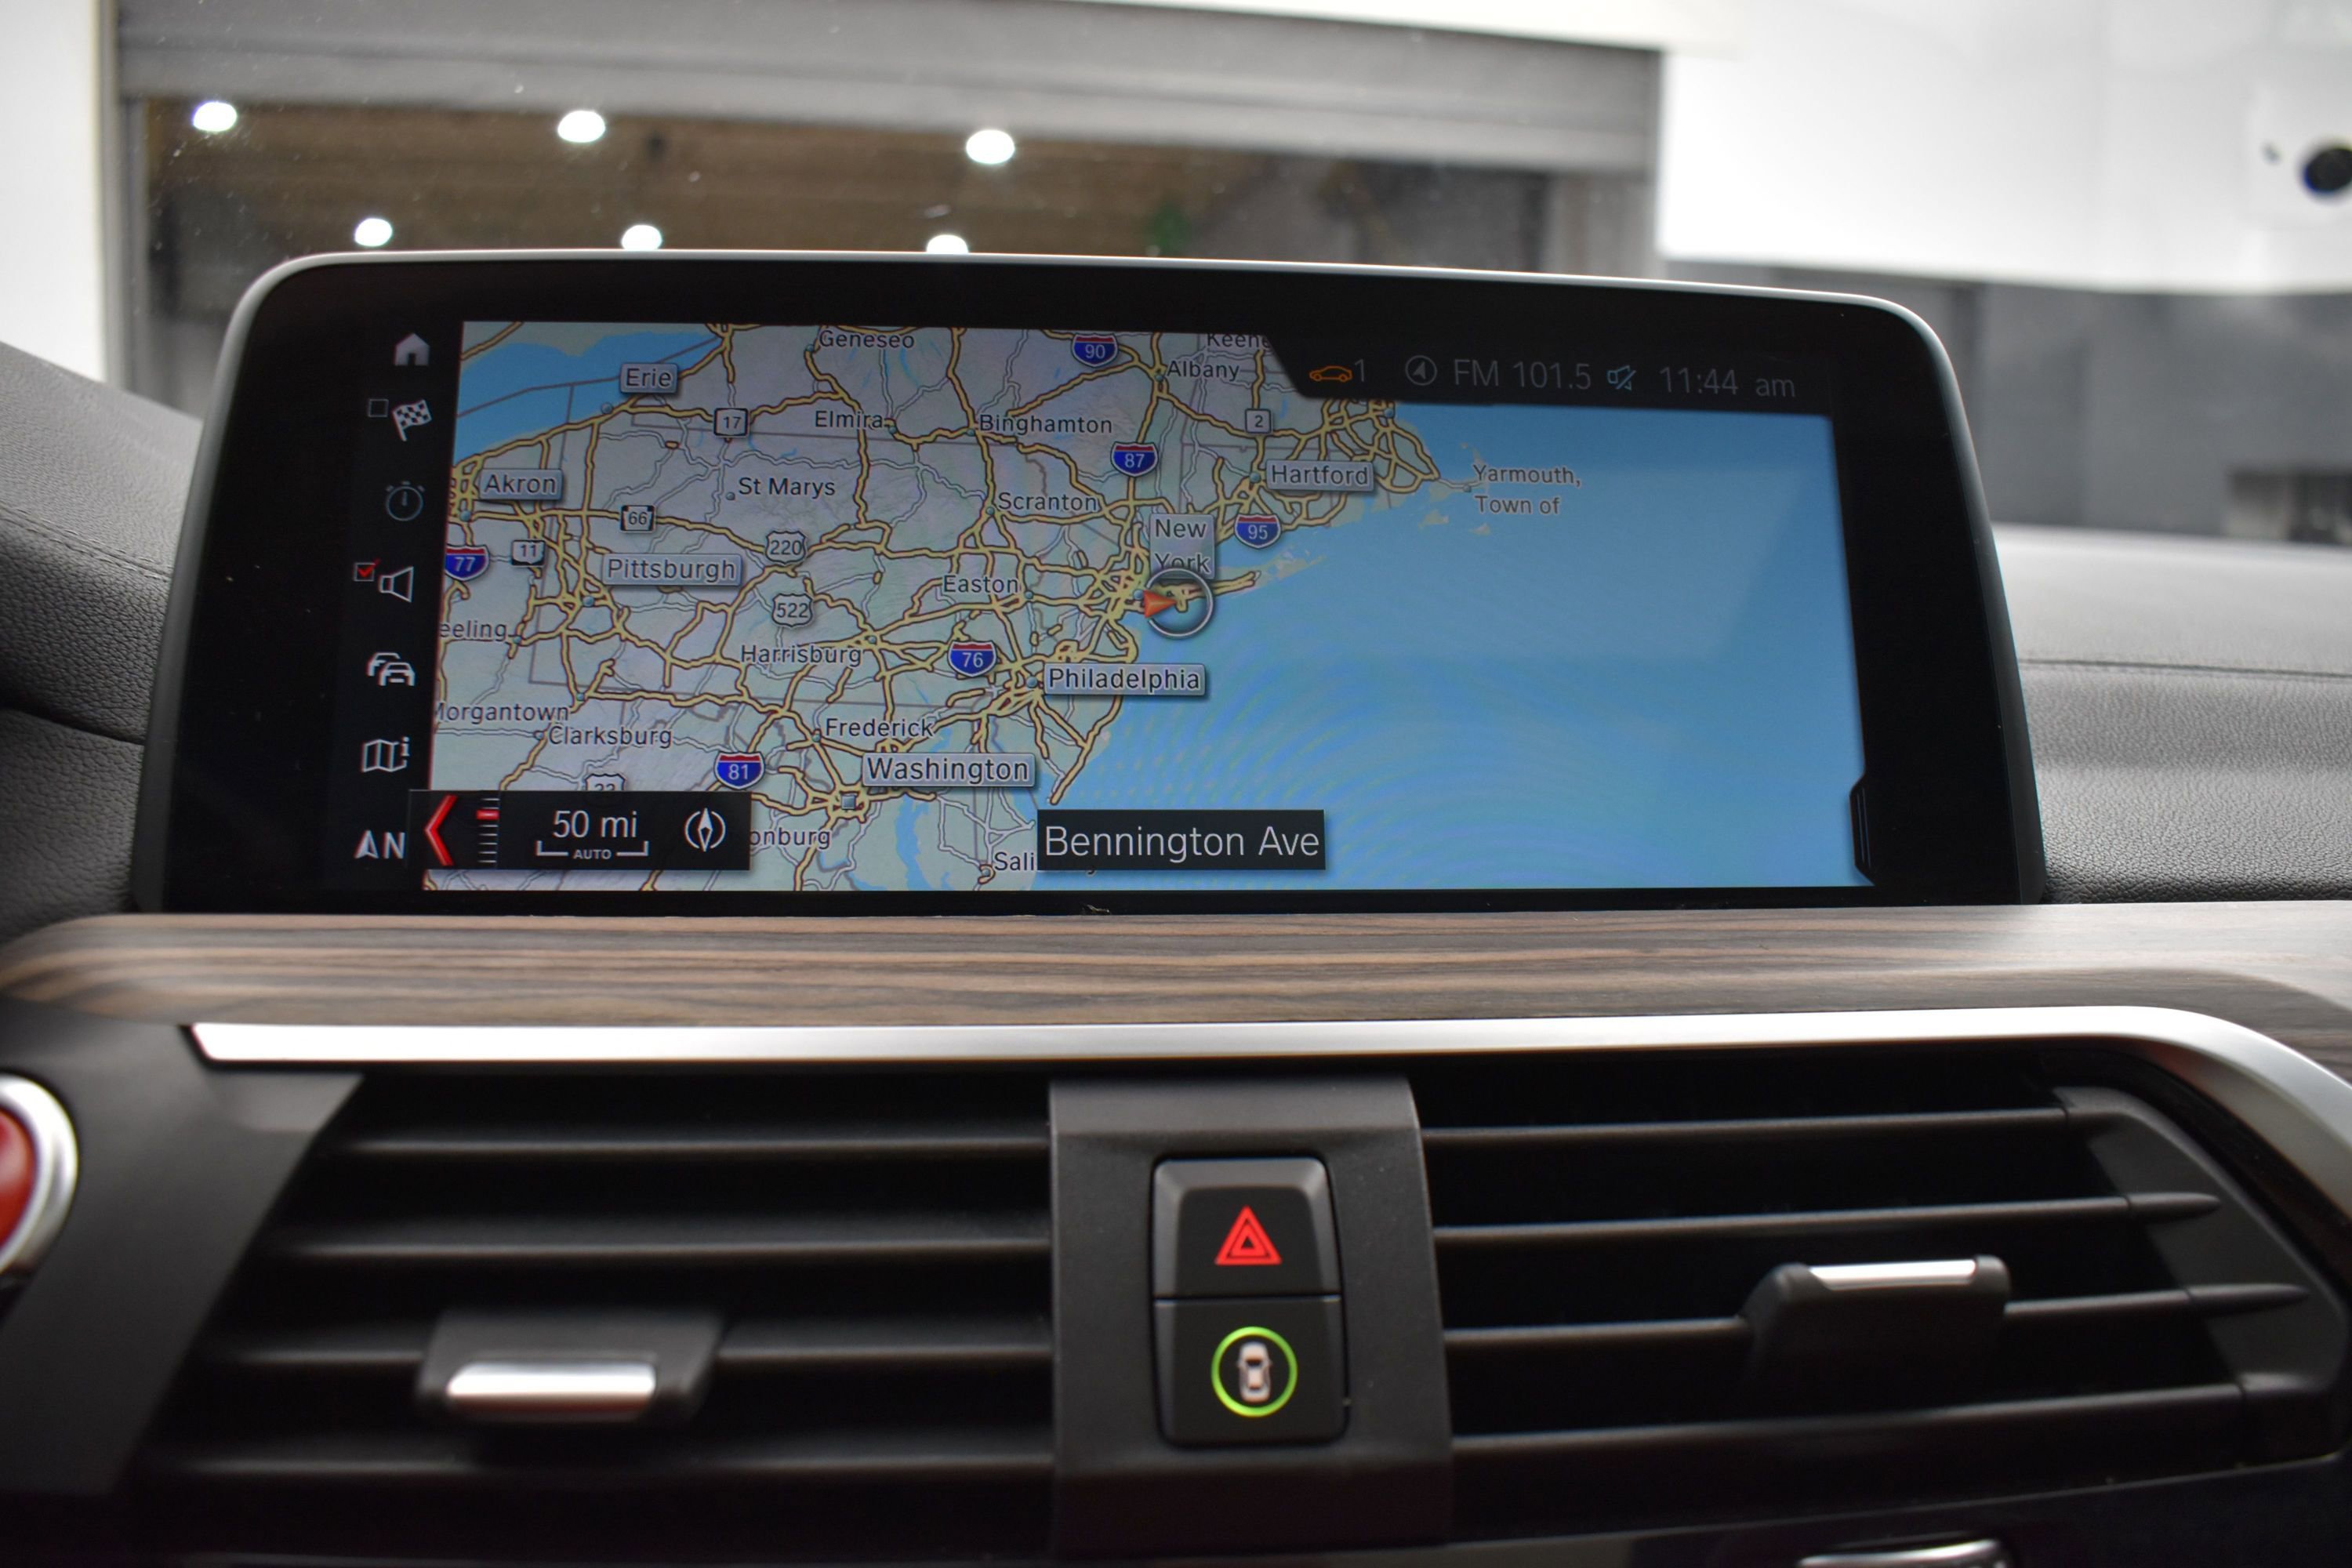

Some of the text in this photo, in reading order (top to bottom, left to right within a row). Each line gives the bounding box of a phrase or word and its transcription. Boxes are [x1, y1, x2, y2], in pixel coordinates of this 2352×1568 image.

[819, 330, 915, 349] Geneseo
[1084, 344, 1105, 360] 90
[626, 368, 672, 388] Erie
[1167, 360, 1240, 381] Albany
[1454, 361, 1591, 390] FM 101.5
[1660, 366, 1795, 397] 11:44 am
[724, 416, 741, 430] 17
[815, 411, 884, 429] Elmira
[980, 415, 1112, 434] Binghamton
[1254, 416, 1264, 428] 2
[1124, 453, 1145, 468] 87
[485, 475, 556, 494] Akron
[1272, 466, 1368, 486] Hartford
[1473, 464, 1581, 488] Yarmouth,
[739, 477, 836, 499] St Marys
[999, 493, 1097, 511] Scranton
[1475, 495, 1560, 514] Town of
[629, 511, 648, 525] 66
[1156, 519, 1206, 538] New
[1247, 524, 1269, 540] 95
[770, 540, 803, 556] 220
[455, 557, 475, 572] 77
[608, 559, 735, 584] Pittsburgh
[1155, 554, 1210, 572] York
[943, 575, 1018, 593] Easton
[777, 603, 809, 619] 522
[440, 620, 507, 642] eeling
[742, 645, 862, 666] Harrisburg
[962, 652, 984, 668] 76
[1050, 669, 1199, 693] Philadelphia
[550, 726, 671, 748] Clarksburg
[826, 718, 934, 737] Frederick
[728, 764, 749, 780] 81
[867, 758, 1028, 783] Washington
[553, 811, 637, 838] 50 mi
[750, 827, 830, 849] onburg
[1046, 826, 1319, 862] Bennington Ave
[573, 849, 612, 859] AUTO
